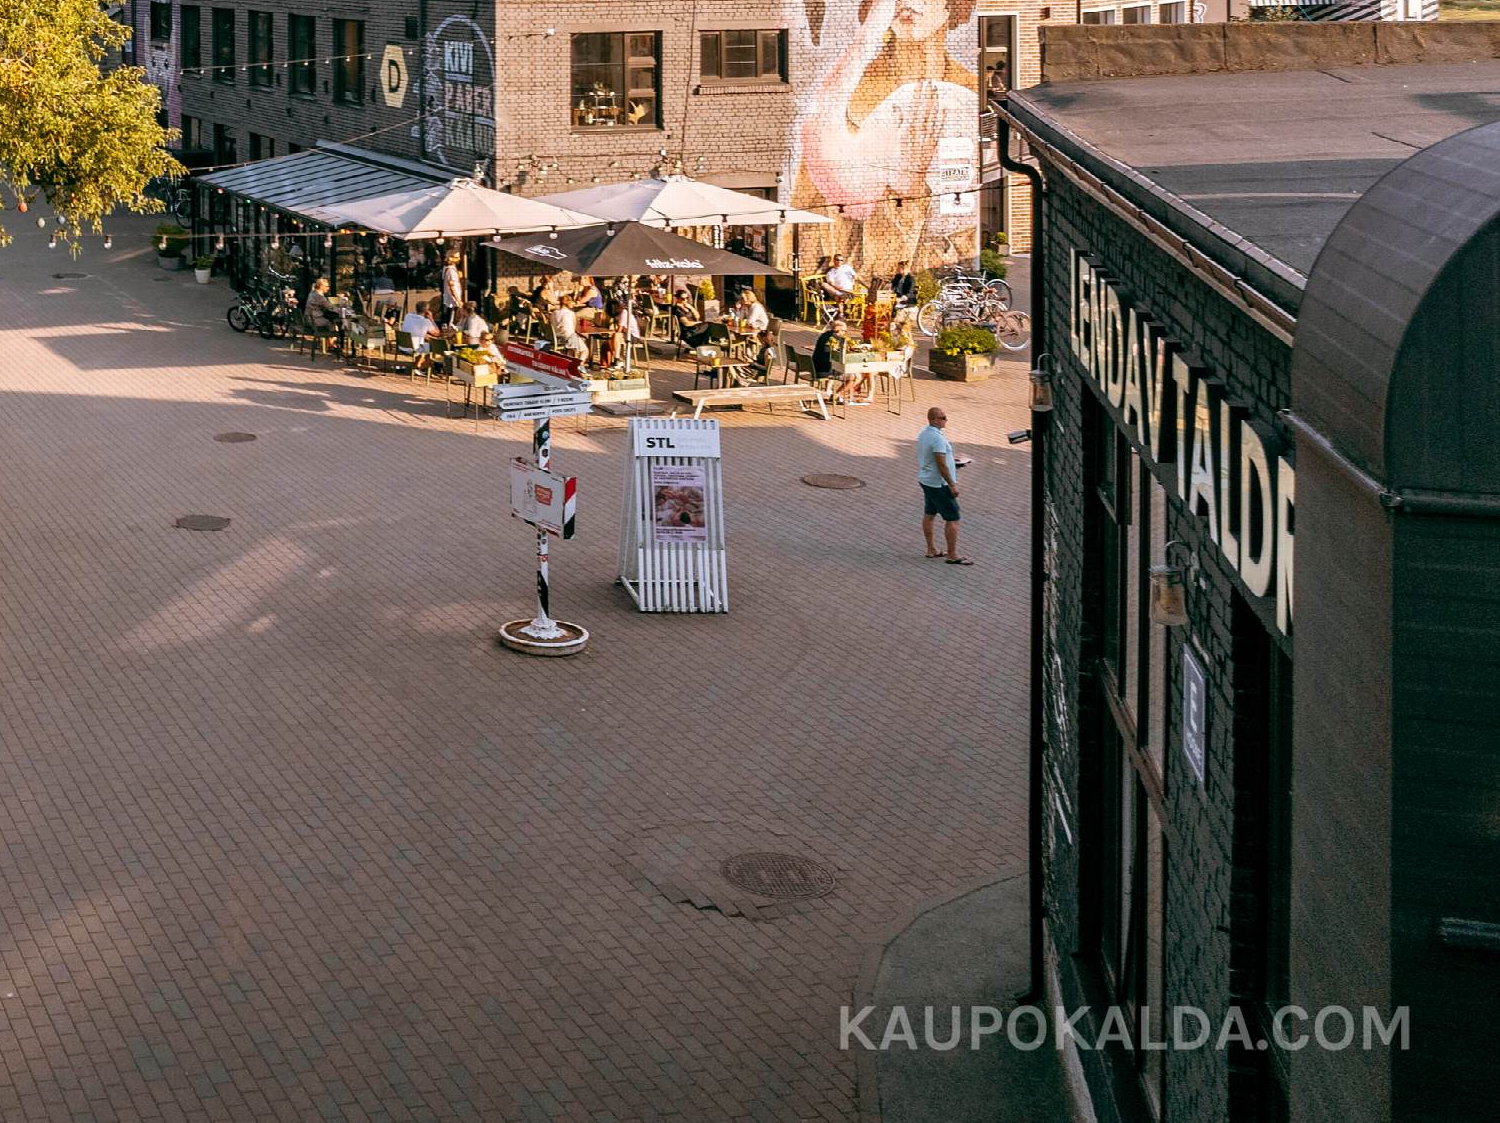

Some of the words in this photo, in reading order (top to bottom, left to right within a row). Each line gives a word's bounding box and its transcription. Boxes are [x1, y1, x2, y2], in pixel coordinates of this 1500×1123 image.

[443, 41, 474, 75] KIVI
[388, 59, 401, 93] D
[646, 437, 675, 449] STL
